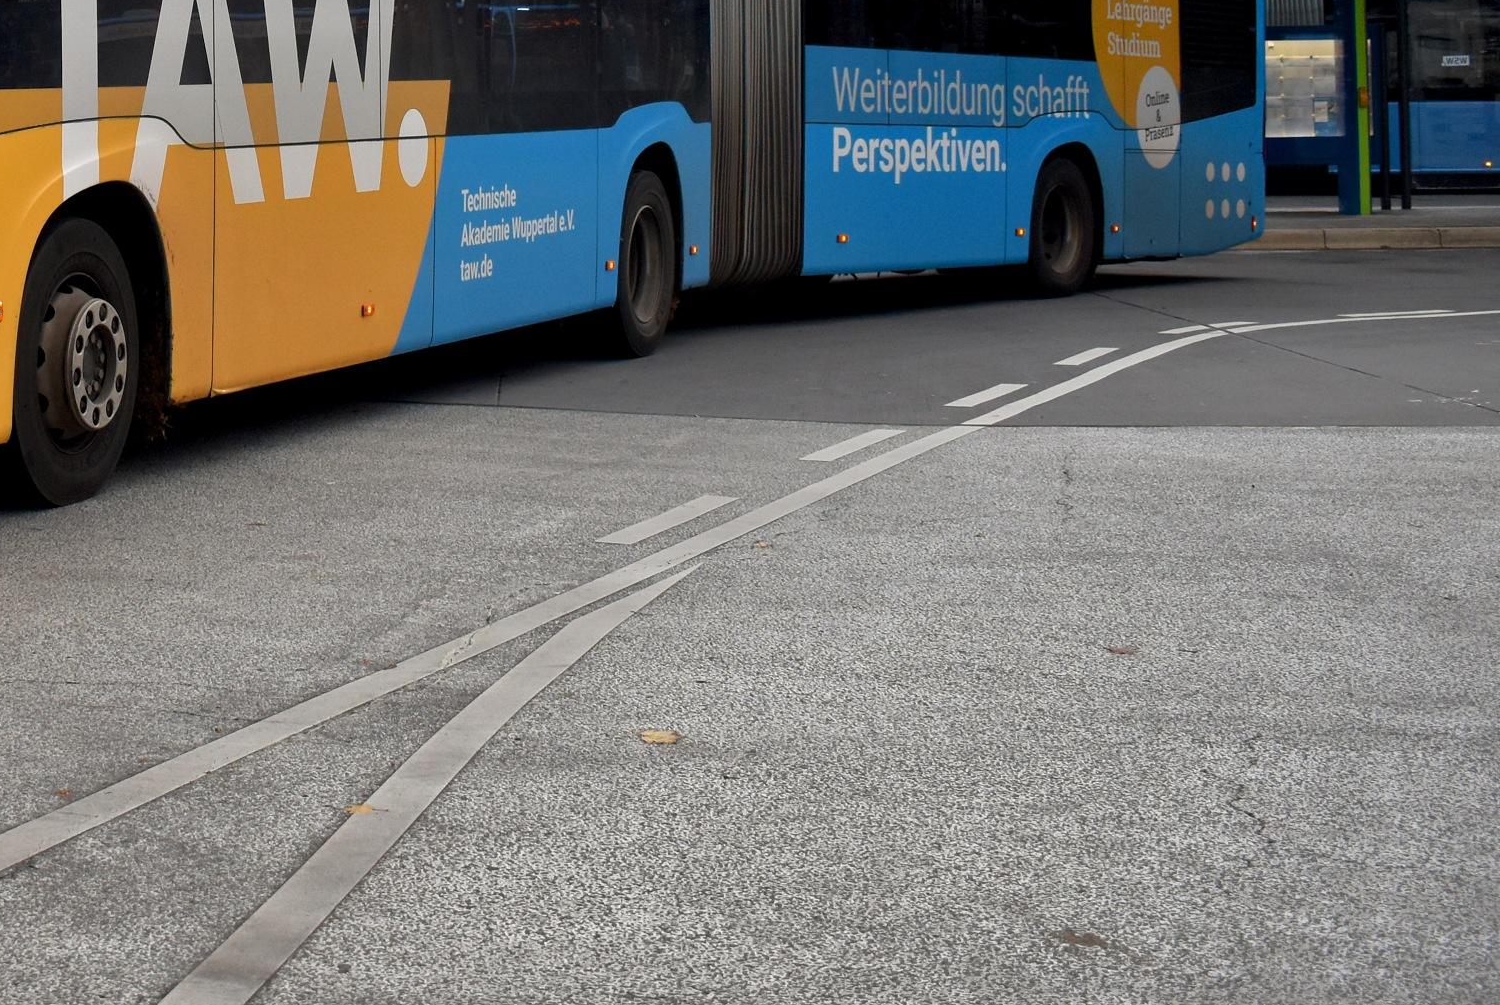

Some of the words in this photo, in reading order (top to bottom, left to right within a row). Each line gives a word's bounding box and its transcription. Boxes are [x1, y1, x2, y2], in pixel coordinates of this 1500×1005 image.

[1107, 32, 1162, 58] Studium
[832, 66, 1005, 127] Weiterbildung
[1012, 73, 1090, 120] schafft
[1145, 91, 1170, 107] Online
[1156, 108, 1161, 122] &
[832, 126, 1006, 184] Perspektiven.
[461, 183, 516, 212] Technische
[461, 219, 510, 247] Akademie
[512, 210, 558, 242] Wuppertal
[559, 208, 575, 232] e.V.
[460, 253, 493, 282] taw.de
